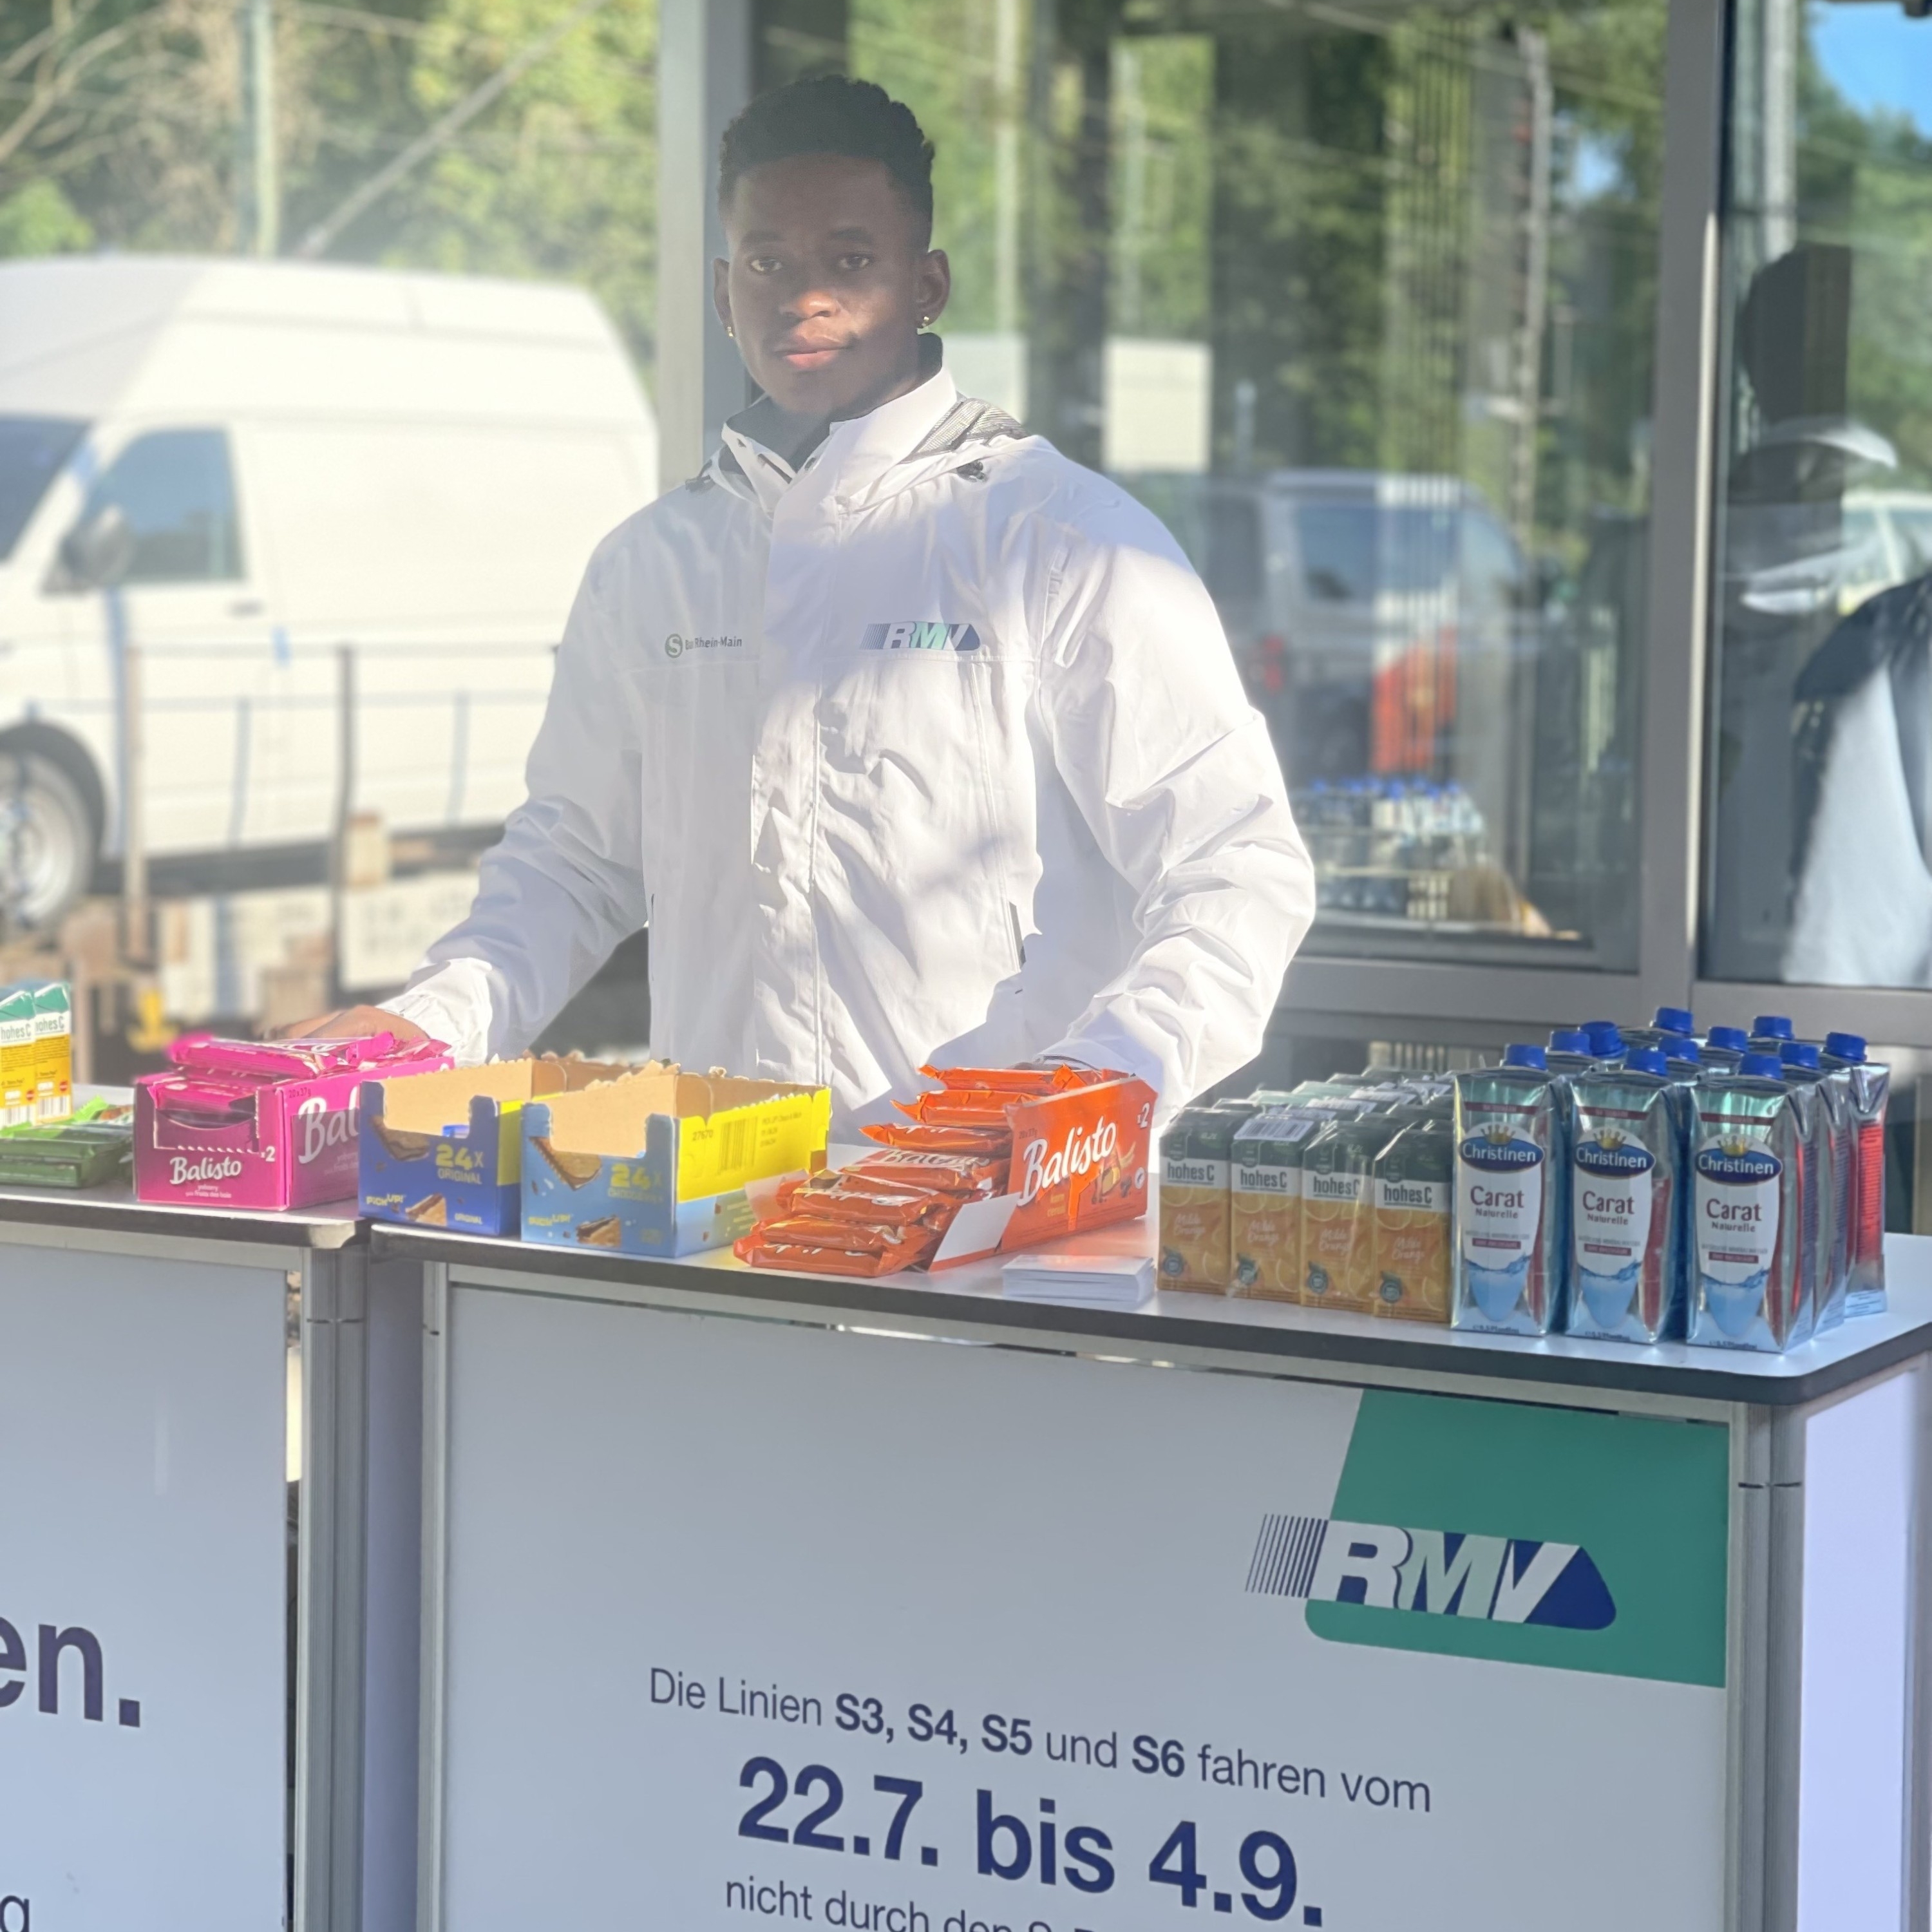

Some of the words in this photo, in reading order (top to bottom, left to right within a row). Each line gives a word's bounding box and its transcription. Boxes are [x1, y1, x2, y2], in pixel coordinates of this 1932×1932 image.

[695, 636, 743, 648] Rhein-Main
[883, 621, 971, 650] RMV
[1017, 1115, 1117, 1206] Balisto
[1463, 1142, 1536, 1162] Christinen
[1576, 1147, 1647, 1168] Christinen
[169, 1157, 242, 1185] Balisto
[1167, 1162, 1205, 1180] hohes
[1207, 1164, 1215, 1181] C
[1698, 1154, 1774, 1175] Christinen
[438, 1168, 482, 1184] ORIGINAL
[1240, 1169, 1278, 1188] hohes
[1280, 1171, 1287, 1188] C
[1313, 1176, 1352, 1195] hohes
[1384, 1184, 1423, 1203] hohes
[1425, 1186, 1432, 1204] C
[1470, 1186, 1524, 1208] Carat
[1582, 1190, 1635, 1215] Carat
[1475, 1208, 1519, 1219] Naturelle
[1587, 1213, 1629, 1225] Naturelle
[1707, 1198, 1763, 1222] Carat
[1711, 1221, 1756, 1233] Naturelle
[1309, 1519, 1581, 1623] RMV
[650, 1667, 706, 1710] Die
[719, 1676, 822, 1727] Linien
[835, 1692, 895, 1745] S3,
[907, 1703, 968, 1755] S4,
[981, 1713, 1033, 1756] S5
[1046, 1730, 1118, 1769] und
[1131, 1734, 1186, 1778] S6
[1197, 1743, 1326, 1799] fahren
[1340, 1772, 1431, 1814] vom
[737, 1756, 939, 1867] 22.7.
[976, 1788, 1115, 1894] bis
[1148, 1819, 1323, 1928] 4.9.
[726, 1875, 813, 1921] nicht
[824, 1889, 930, 1932] durch
